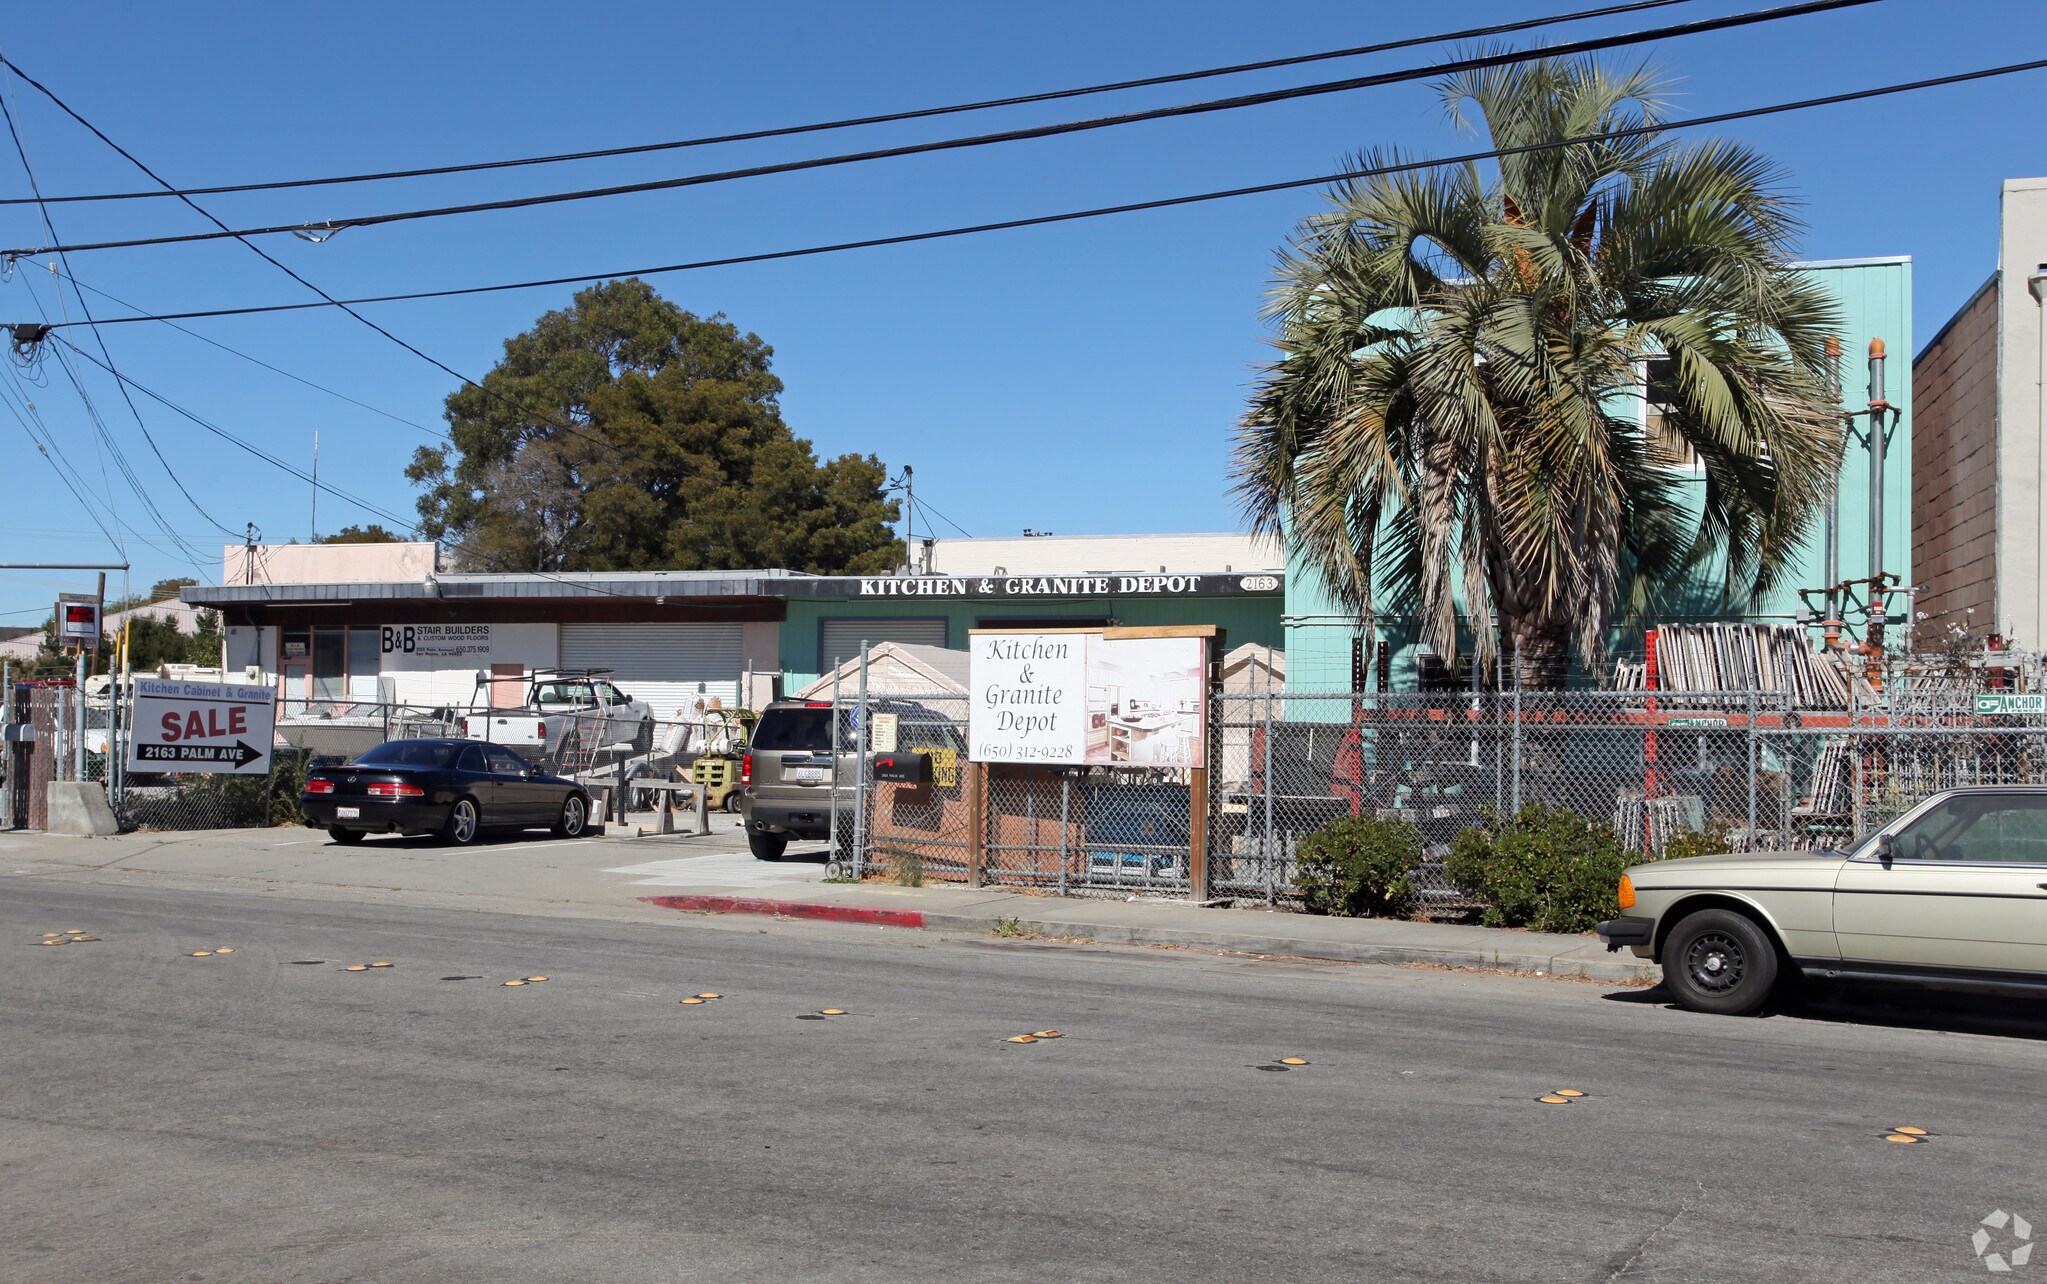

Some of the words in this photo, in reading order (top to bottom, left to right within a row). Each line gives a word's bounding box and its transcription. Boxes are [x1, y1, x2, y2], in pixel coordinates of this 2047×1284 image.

[859, 577, 967, 595] KITCHEN
[978, 579, 994, 594] &
[1005, 577, 1109, 595] GRANITE
[1119, 576, 1201, 593] DEPOT
[1245, 577, 1274, 590] 2163
[417, 626, 442, 635] STAIR
[445, 625, 490, 635] BUILDERS
[455, 645, 490, 654] 650.375.1909
[986, 636, 1069, 660] Kitchen
[1019, 663, 1035, 684] &
[139, 681, 180, 695] Kitchen
[183, 683, 221, 697] Cabinet
[225, 687, 233, 698] &
[237, 687, 271, 700] Granite
[985, 683, 1062, 709] Granite
[2000, 695, 2043, 712] ANCHOR
[161, 706, 248, 743] SALE
[996, 710, 1058, 739] Depot
[145, 746, 176, 759] 2163
[180, 747, 215, 759] PALM
[219, 748, 244, 760] AVE
[979, 741, 1013, 760] (650)
[1016, 744, 1073, 761] 312-9228
